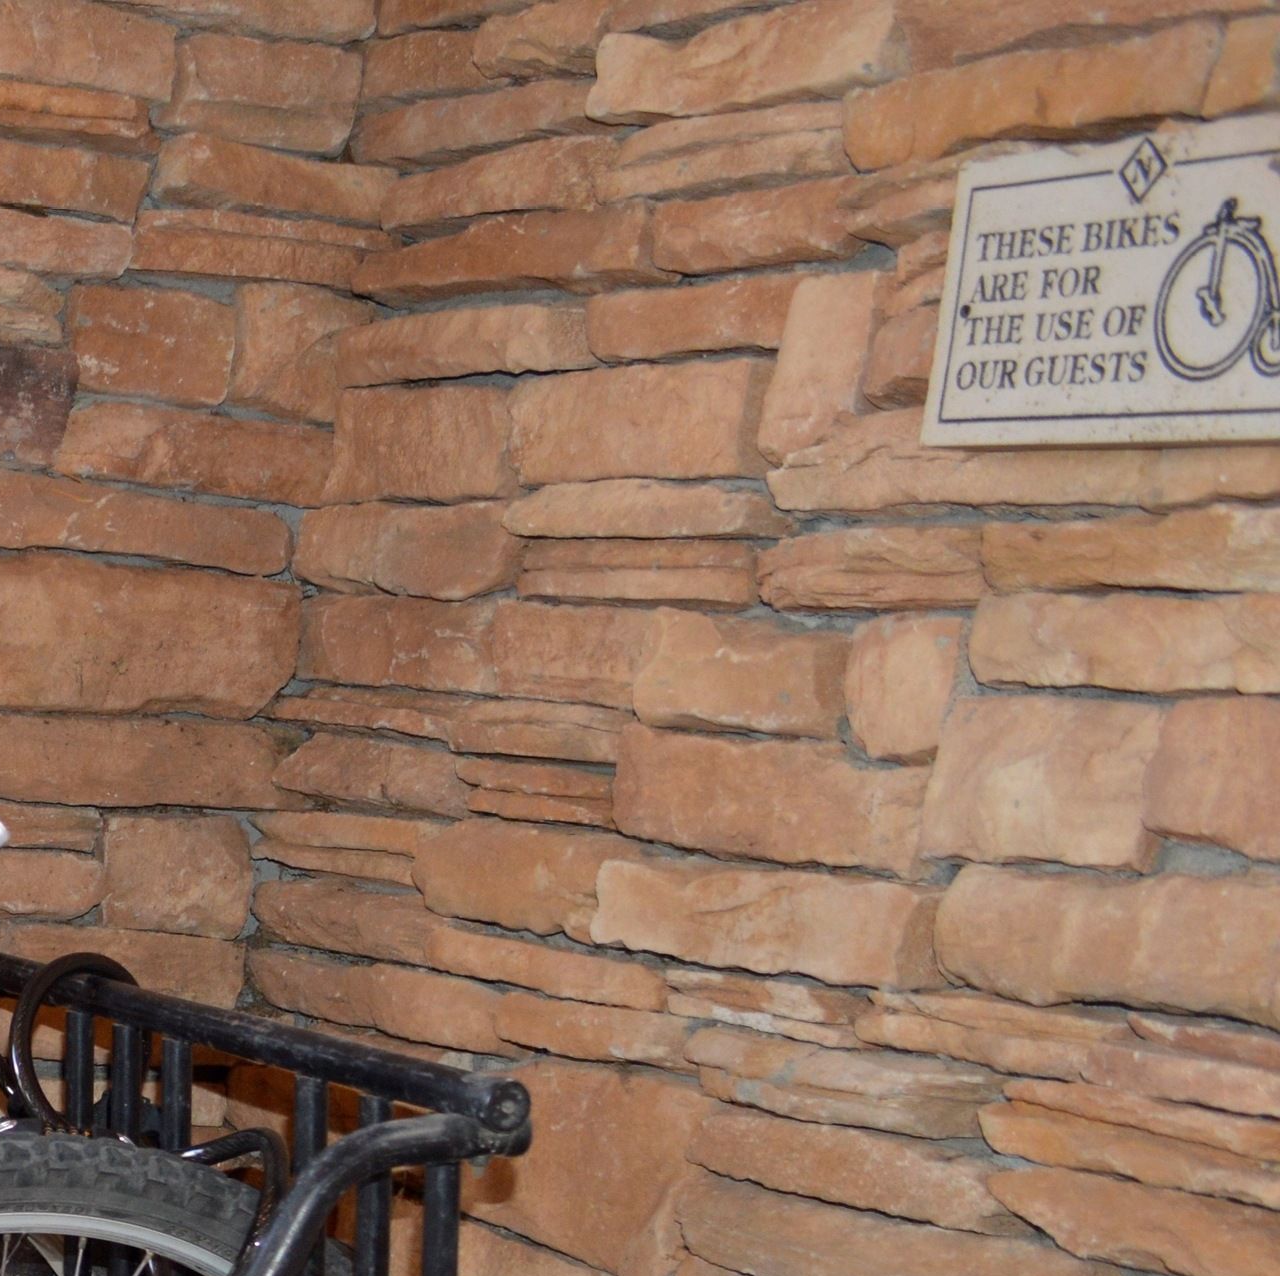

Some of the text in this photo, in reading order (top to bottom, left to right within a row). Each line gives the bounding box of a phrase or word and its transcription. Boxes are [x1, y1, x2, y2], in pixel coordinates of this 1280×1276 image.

[976, 212, 1181, 262] THESE BIKES
[970, 266, 1101, 304] ARE FOR
[964, 304, 1147, 346] THE USE OF
[955, 351, 1148, 390] OUR GUESTS
